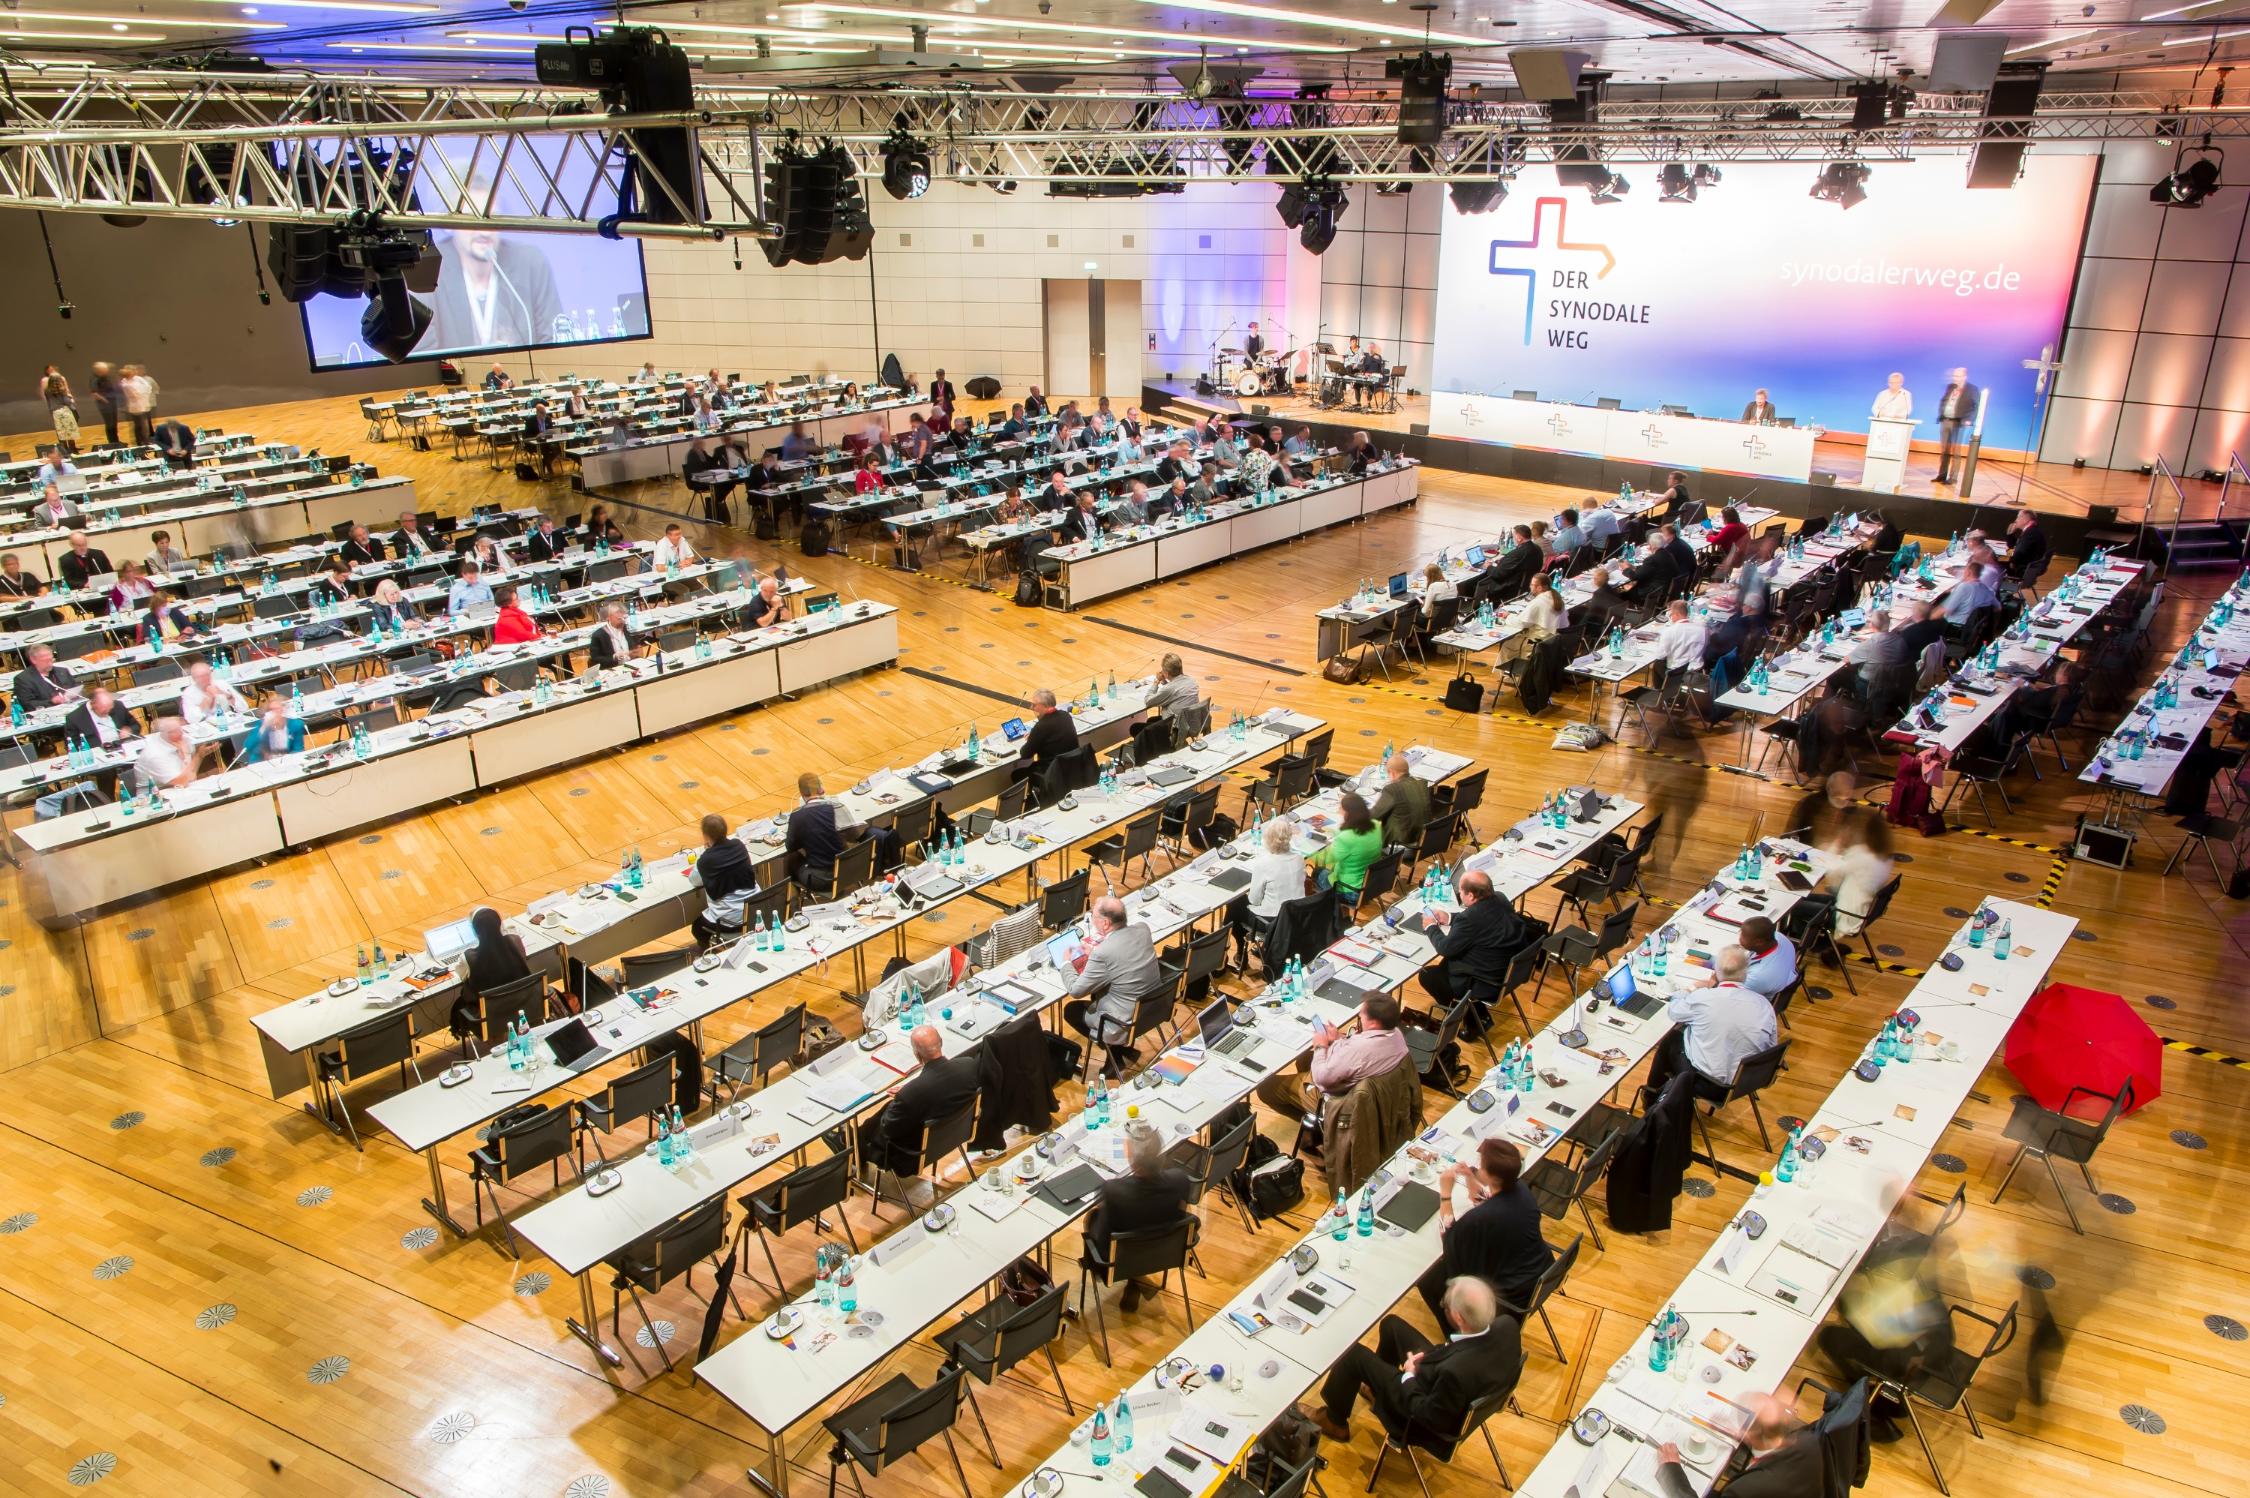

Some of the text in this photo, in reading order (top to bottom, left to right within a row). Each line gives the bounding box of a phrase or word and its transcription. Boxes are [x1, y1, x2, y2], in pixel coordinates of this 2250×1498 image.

[1552, 270, 1590, 289] DER
[1778, 257, 2021, 297] synodalerweg.de
[1549, 300, 1651, 324] SYNODALE
[1547, 329, 1589, 350] WEG
